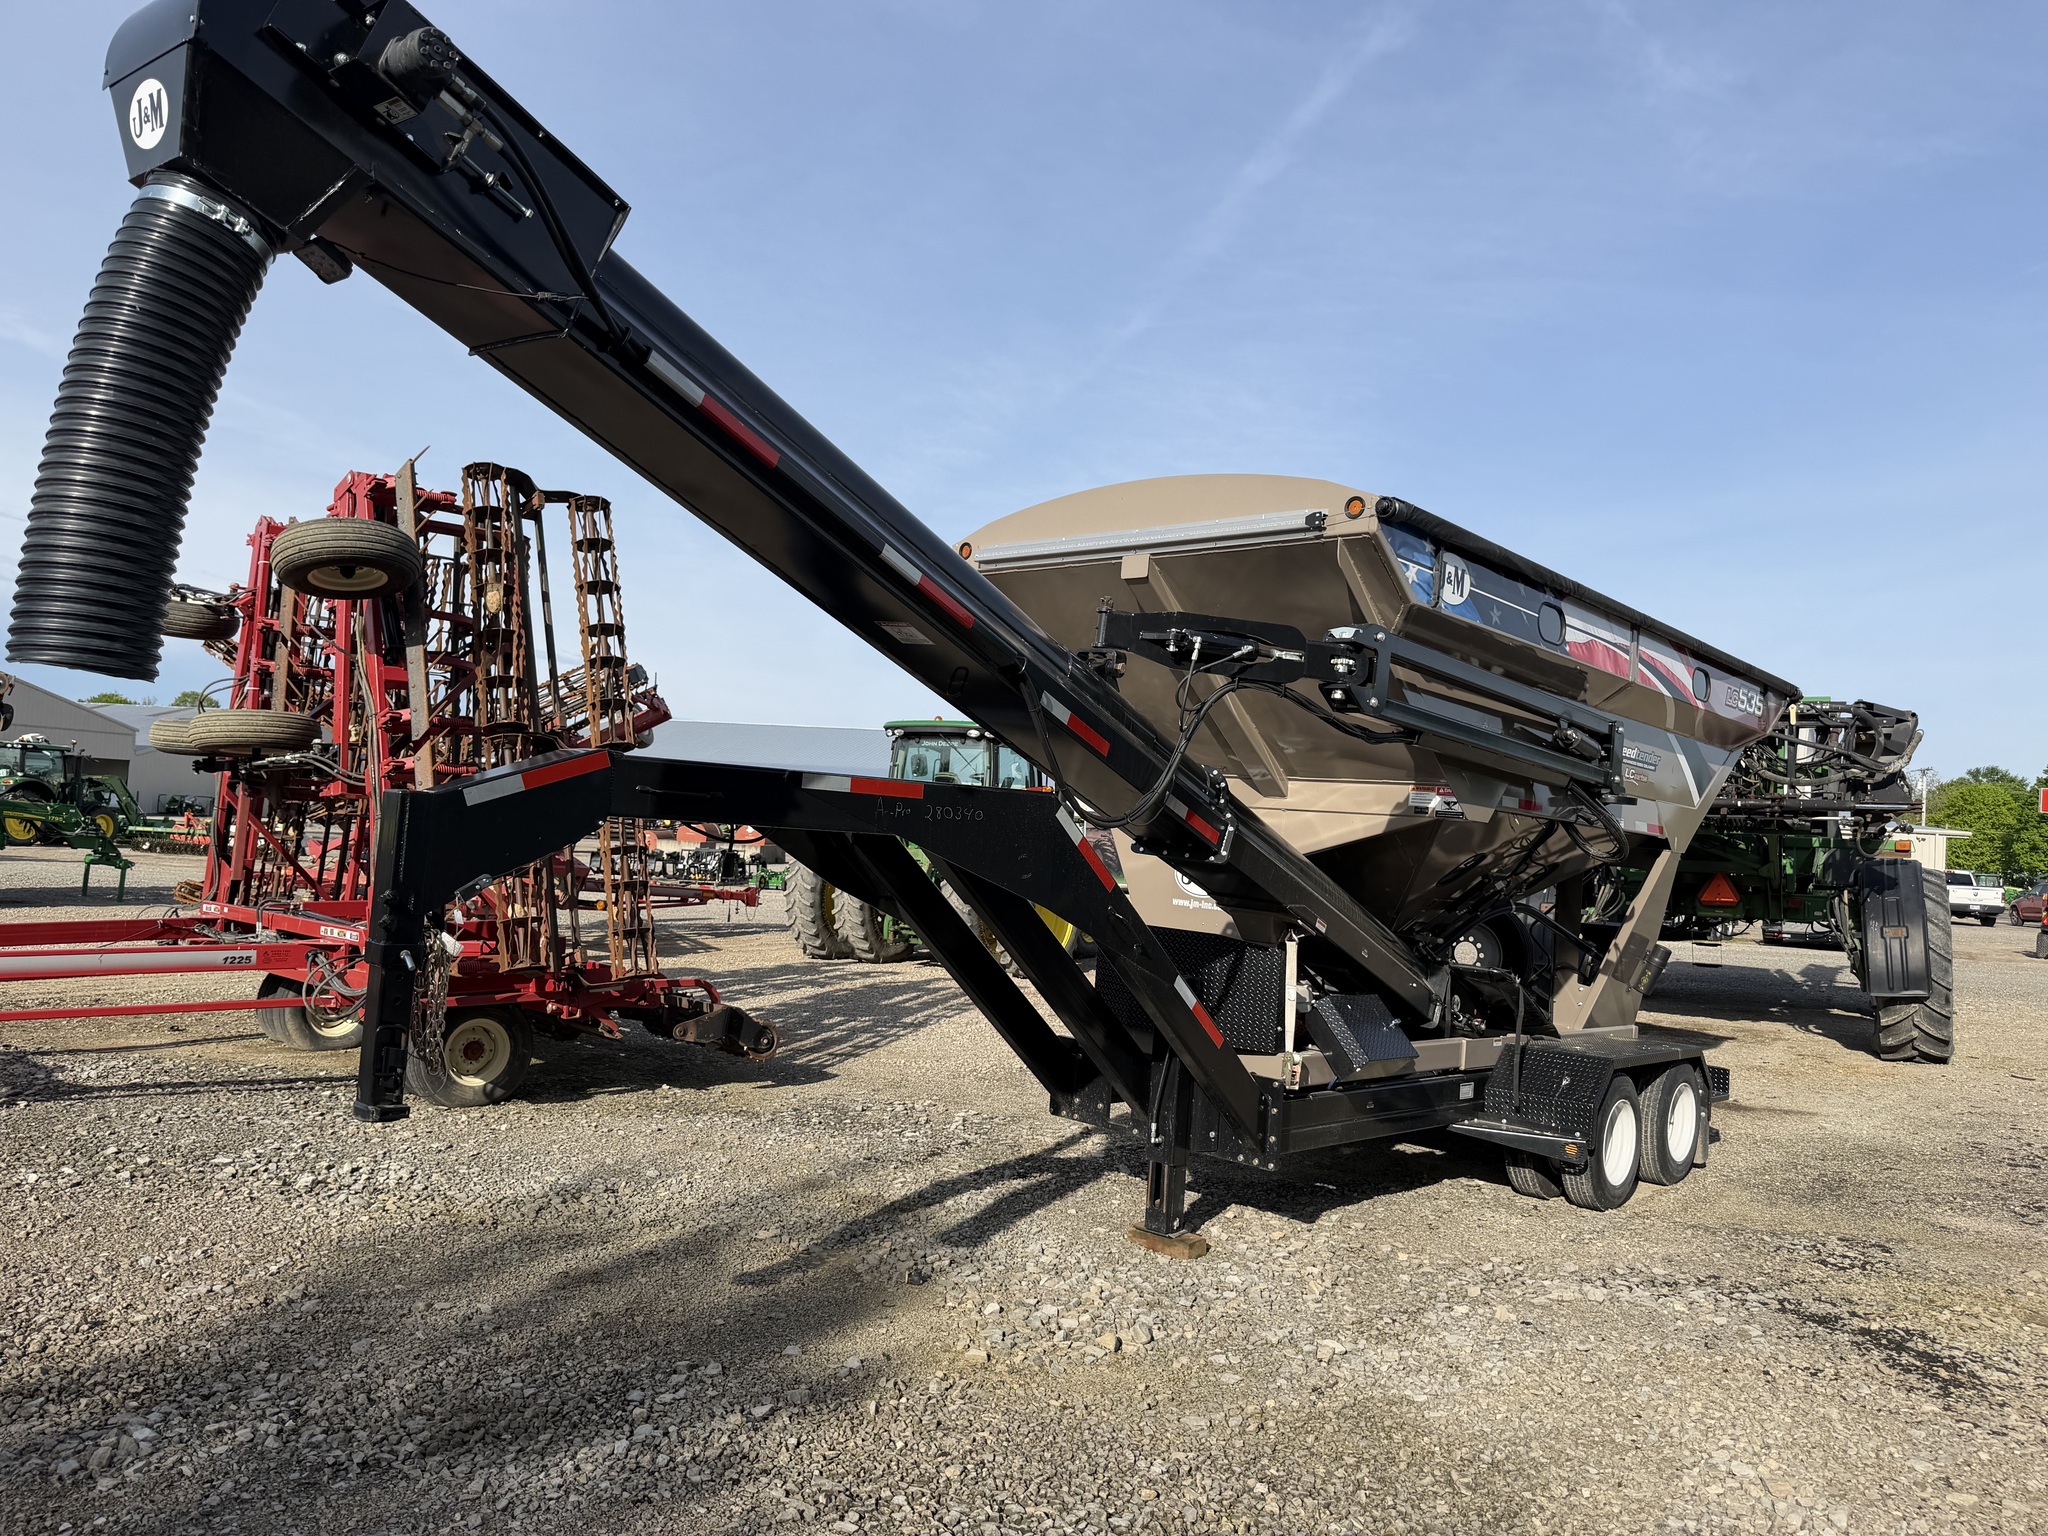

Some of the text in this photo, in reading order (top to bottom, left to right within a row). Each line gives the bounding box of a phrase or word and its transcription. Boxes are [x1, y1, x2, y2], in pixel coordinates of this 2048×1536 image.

[132, 87, 164, 139] J&M
[1440, 560, 1466, 599] J&M
[1622, 746, 1661, 766] eedtender
[925, 804, 984, 822] 280340
[222, 955, 252, 965] 1225
